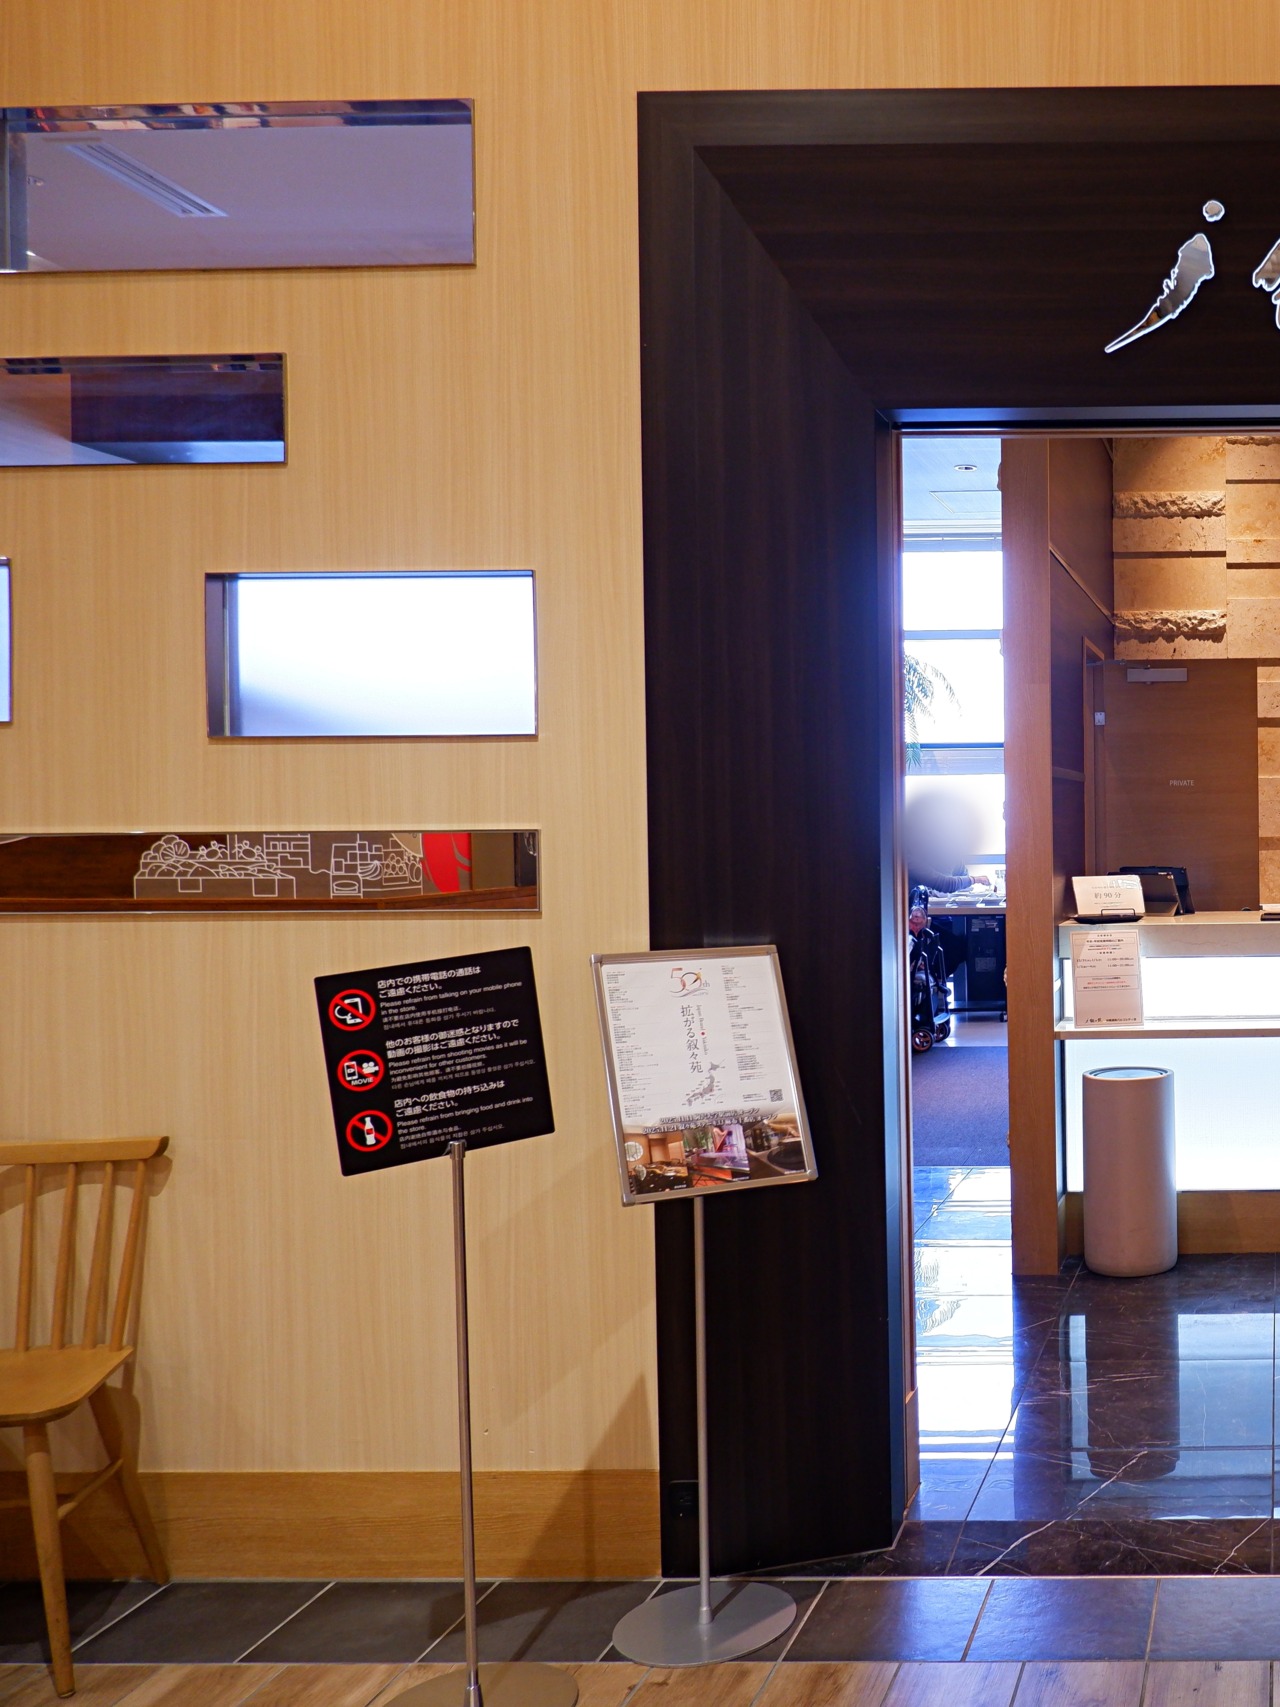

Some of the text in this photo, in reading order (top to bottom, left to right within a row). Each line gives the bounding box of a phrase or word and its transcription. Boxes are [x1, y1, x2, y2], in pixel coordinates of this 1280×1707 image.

[1169, 779, 1195, 787] PRIVATE
[377, 980, 442, 999] ご遠慮ください。
[379, 999, 401, 1008] Please
[402, 996, 422, 1004] refrain
[423, 993, 437, 1001] from
[438, 990, 458, 1000] talking
[468, 987, 482, 995] your
[482, 983, 503, 991] mobile
[503, 980, 522, 989] phone
[681, 1004, 704, 1074] 拡がる叙々苑
[387, 1059, 409, 1068] Please
[410, 1055, 430, 1064] refrain
[431, 1052, 445, 1060] from
[446, 1048, 472, 1059] shooting
[473, 1044, 494, 1053] movies
[389, 1063, 427, 1076] inconvenient
[438, 1058, 454, 1067] other
[455, 1053, 487, 1064] customers.
[351, 1077, 374, 1086] MOVIE
[393, 1078, 505, 1109] 店内への飲食物の持ち込みは
[394, 1097, 458, 1118] ご遠慮ください。
[396, 1118, 418, 1128] Please
[419, 1113, 438, 1123] refrain
[439, 1111, 454, 1119] from
[454, 1106, 479, 1117] bringing
[479, 1103, 493, 1111] food
[506, 1098, 520, 1106] drink
[521, 1095, 533, 1103] into
[397, 1124, 426, 1135] the store.
